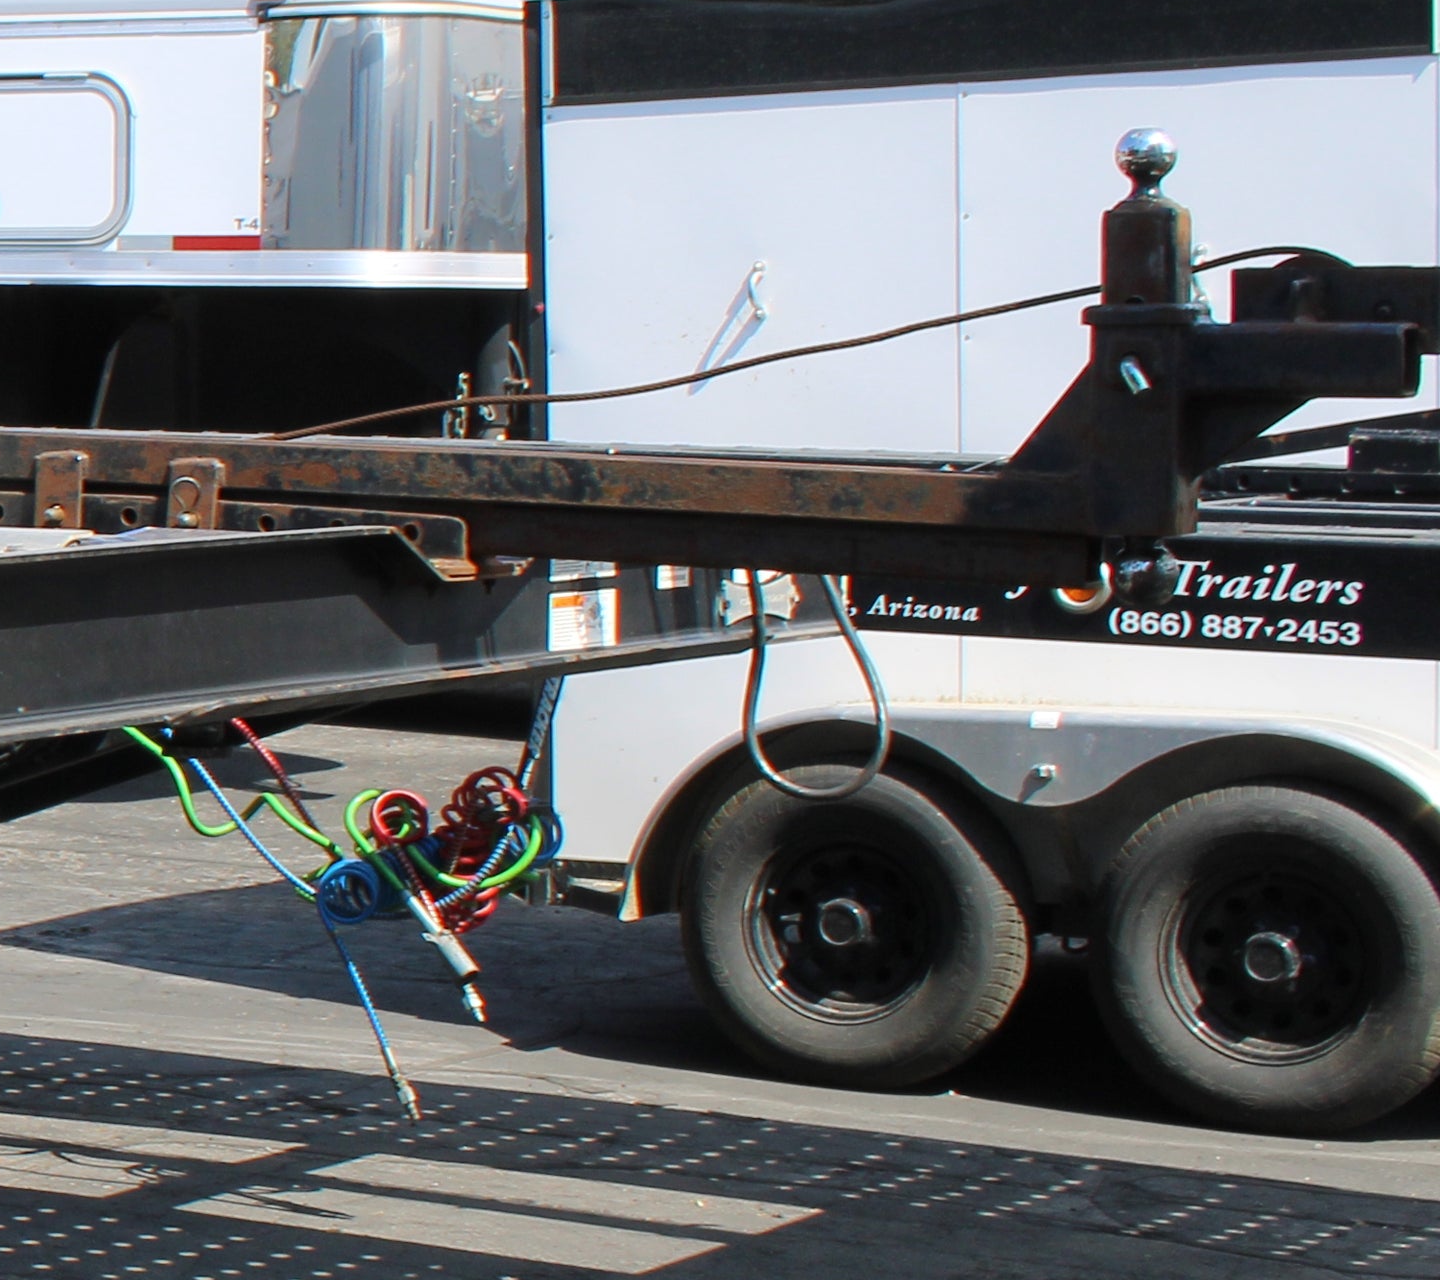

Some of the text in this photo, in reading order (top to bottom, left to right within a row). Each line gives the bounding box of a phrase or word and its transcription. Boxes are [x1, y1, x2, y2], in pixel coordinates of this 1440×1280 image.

[1173, 559, 1365, 605] Trailers
[866, 594, 980, 622] Arizona
[1108, 607, 1193, 639] (866)
